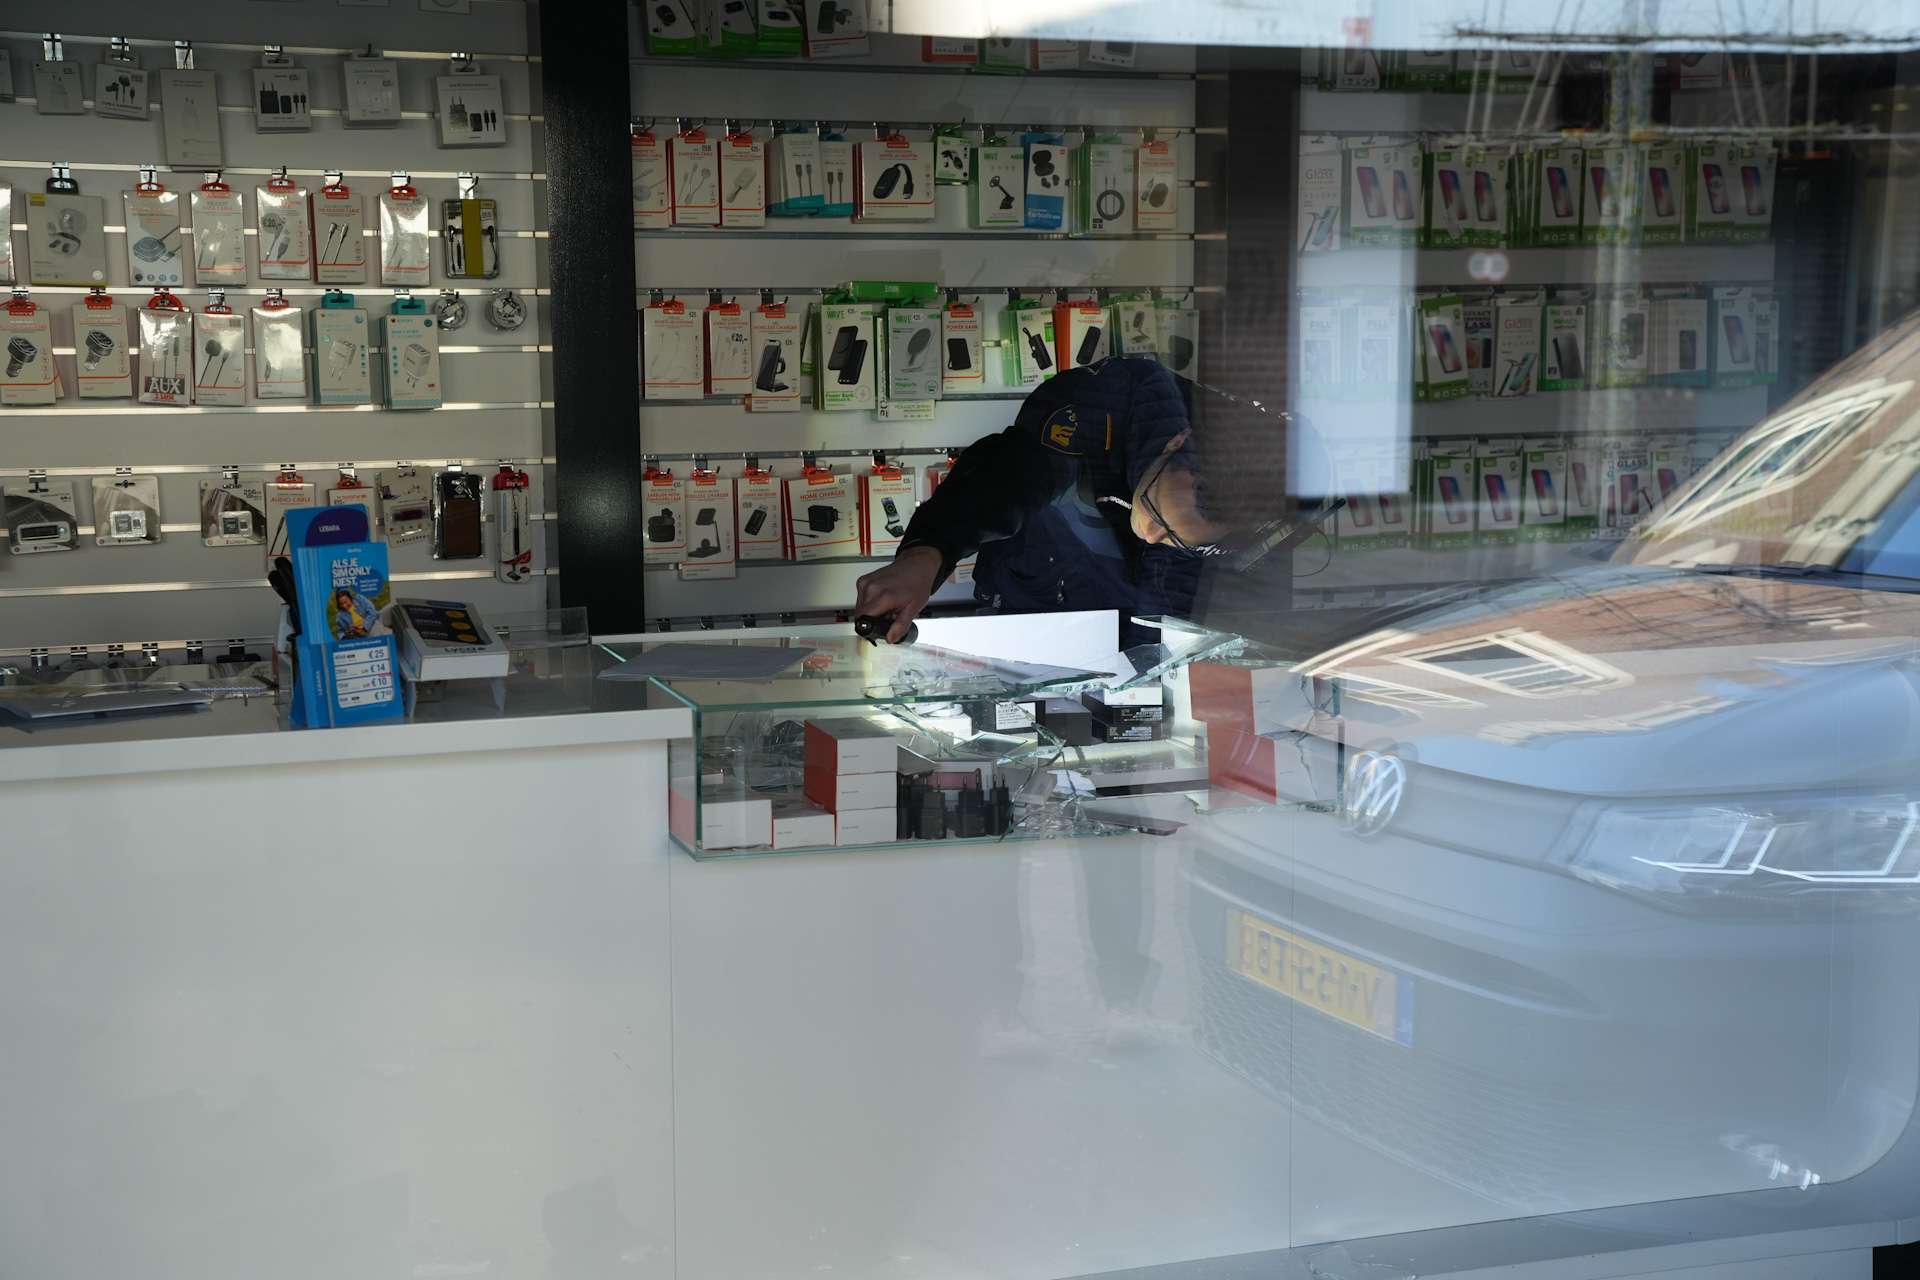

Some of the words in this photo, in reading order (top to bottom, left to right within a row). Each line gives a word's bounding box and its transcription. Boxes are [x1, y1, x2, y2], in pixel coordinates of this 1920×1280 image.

[1305, 168, 1334, 181] Glass
[262, 218, 282, 230] €20,-
[827, 310, 845, 319] WAVE
[894, 315, 912, 324] WAVE
[1504, 319, 1534, 329] Glass
[731, 333, 748, 345] €20,-
[149, 378, 182, 394] AUX
[1617, 460, 1649, 469] GLASS
[819, 490, 846, 498] CHARGER
[319, 525, 341, 533] LEBARA
[332, 559, 348, 569] ALS
[348, 558, 359, 568] JE
[332, 568, 350, 578] SIM
[350, 566, 372, 577] ONLY
[333, 577, 359, 588] KIEST,
